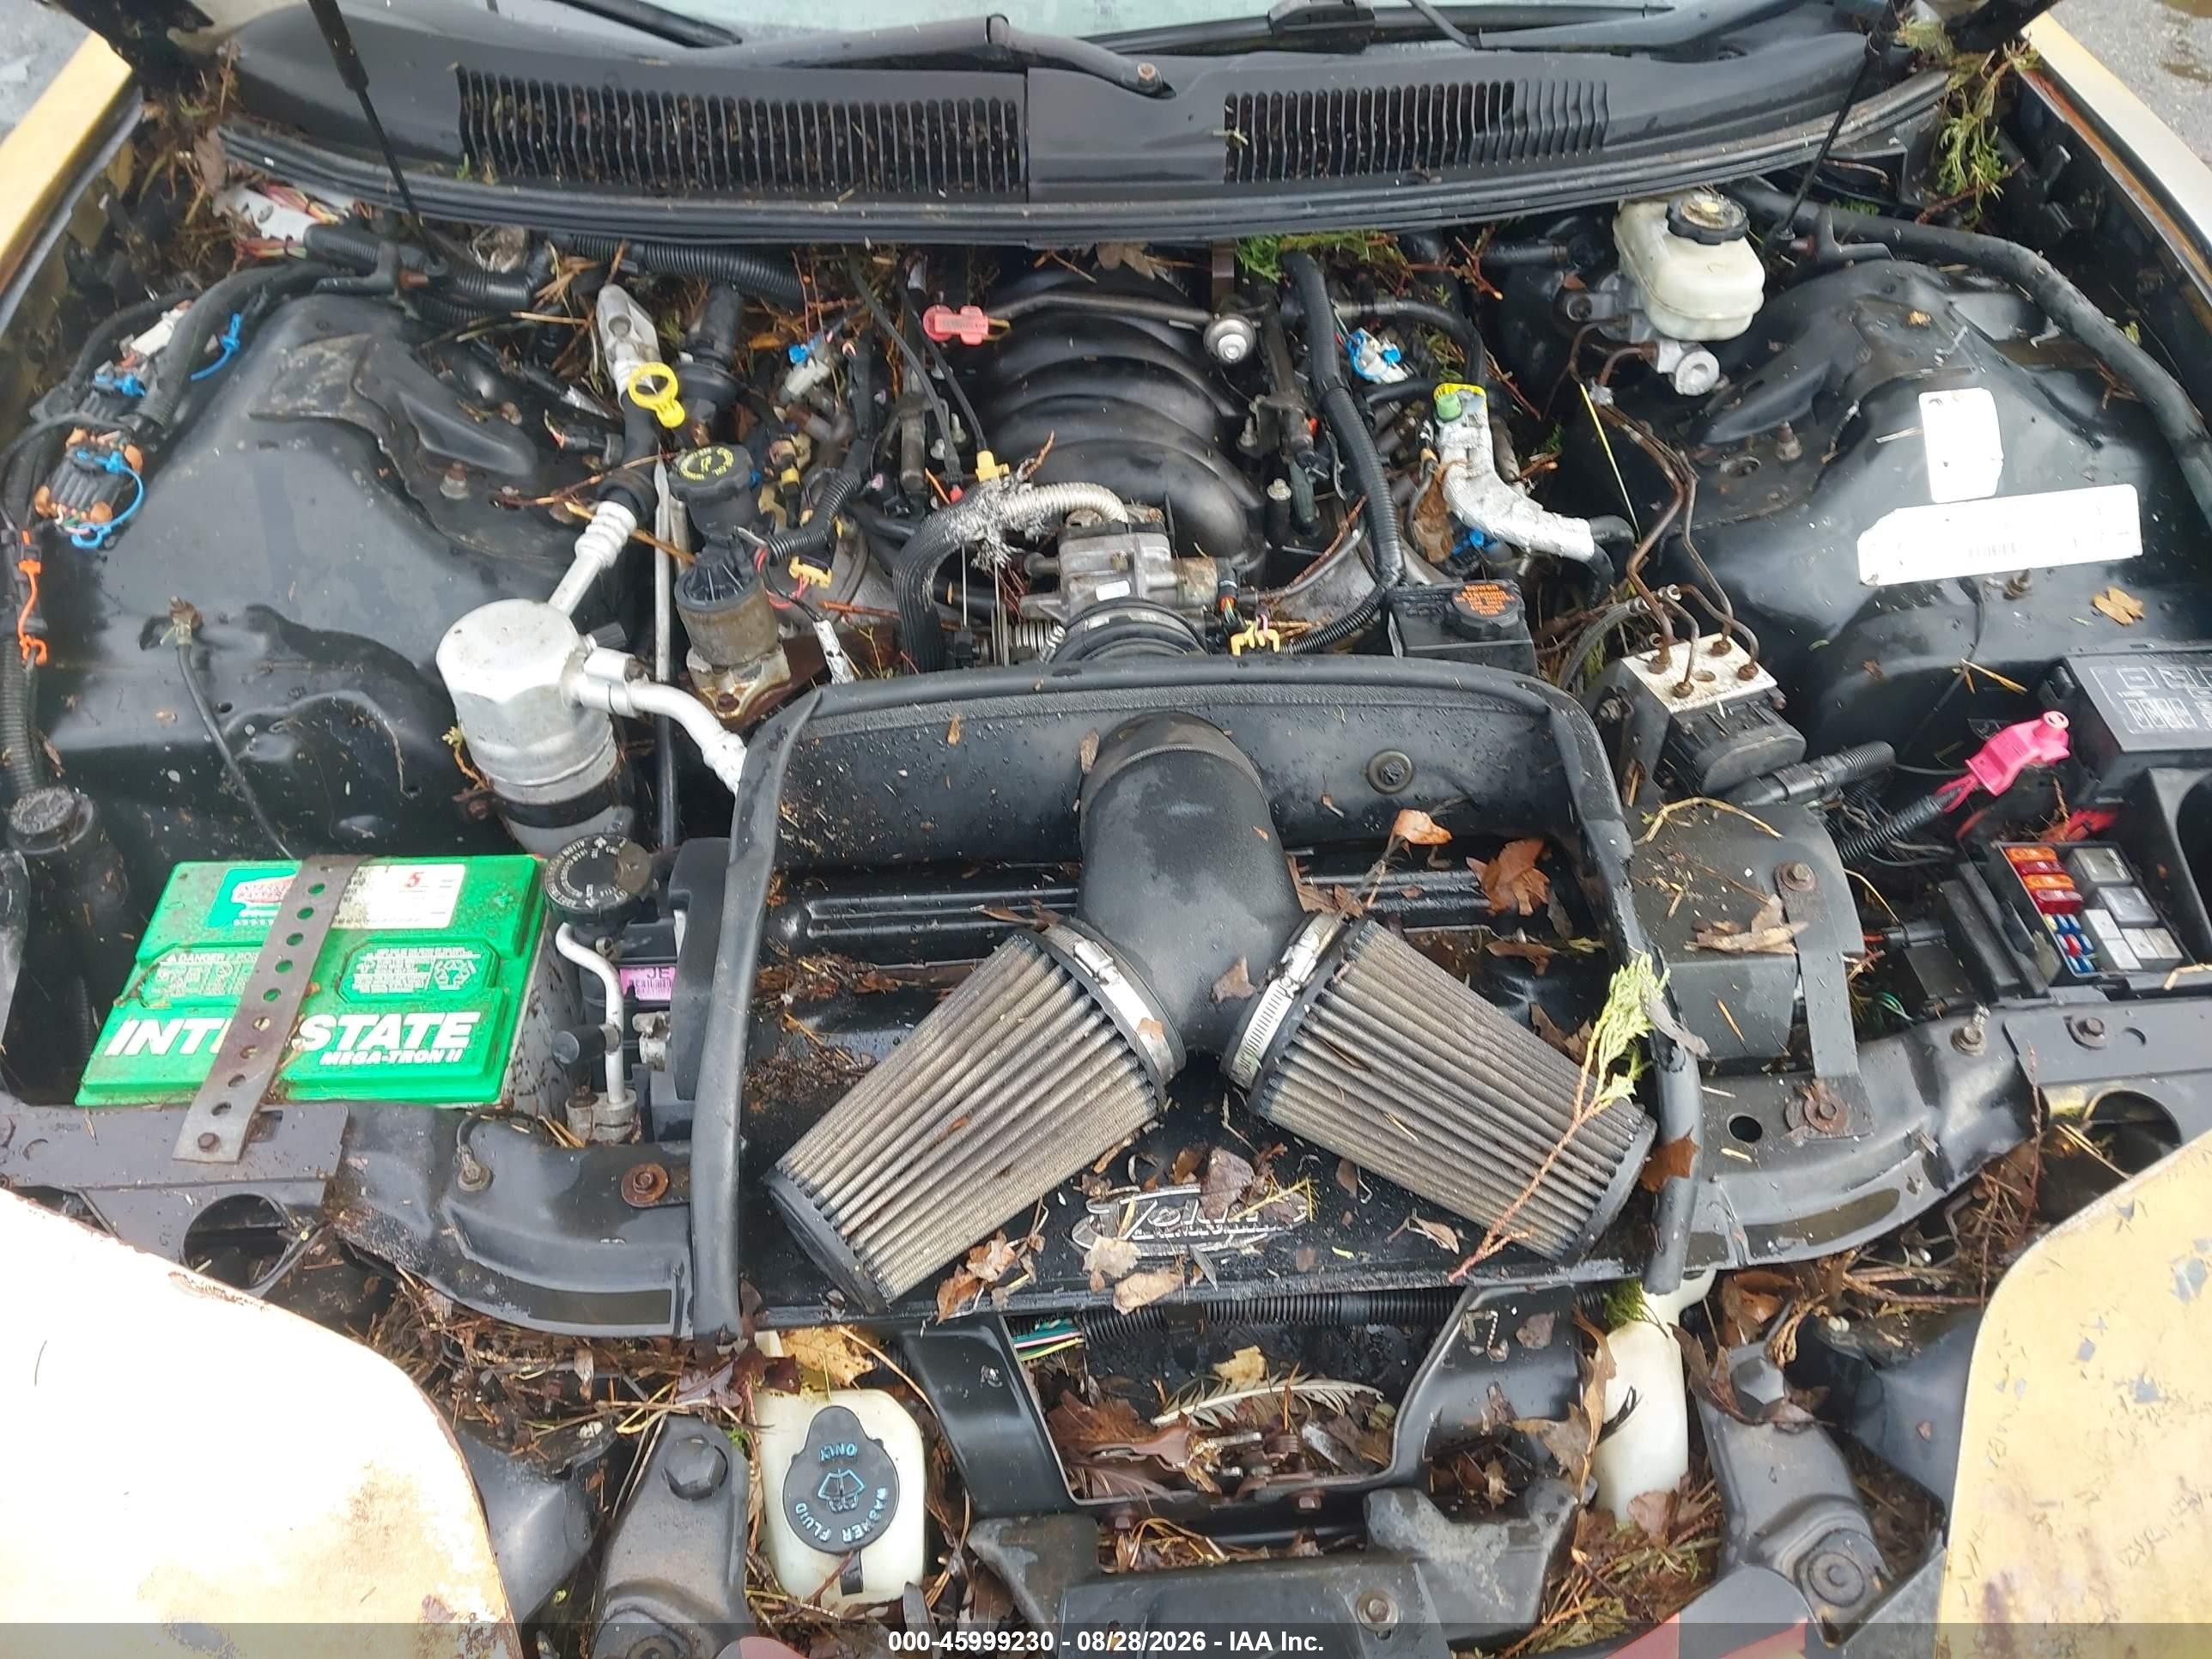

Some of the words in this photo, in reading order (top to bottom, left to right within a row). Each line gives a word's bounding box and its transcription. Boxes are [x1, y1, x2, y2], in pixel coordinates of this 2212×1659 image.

[404, 871, 426, 888] 5
[177, 952, 226, 963] DANGER
[103, 1011, 482, 1057] INTSTATE
[319, 1048, 445, 1066] MEGA-TRON
[819, 1442, 858, 1462] ONLY
[794, 1502, 833, 1542] FLUID
[842, 1486, 889, 1542] WASHER
